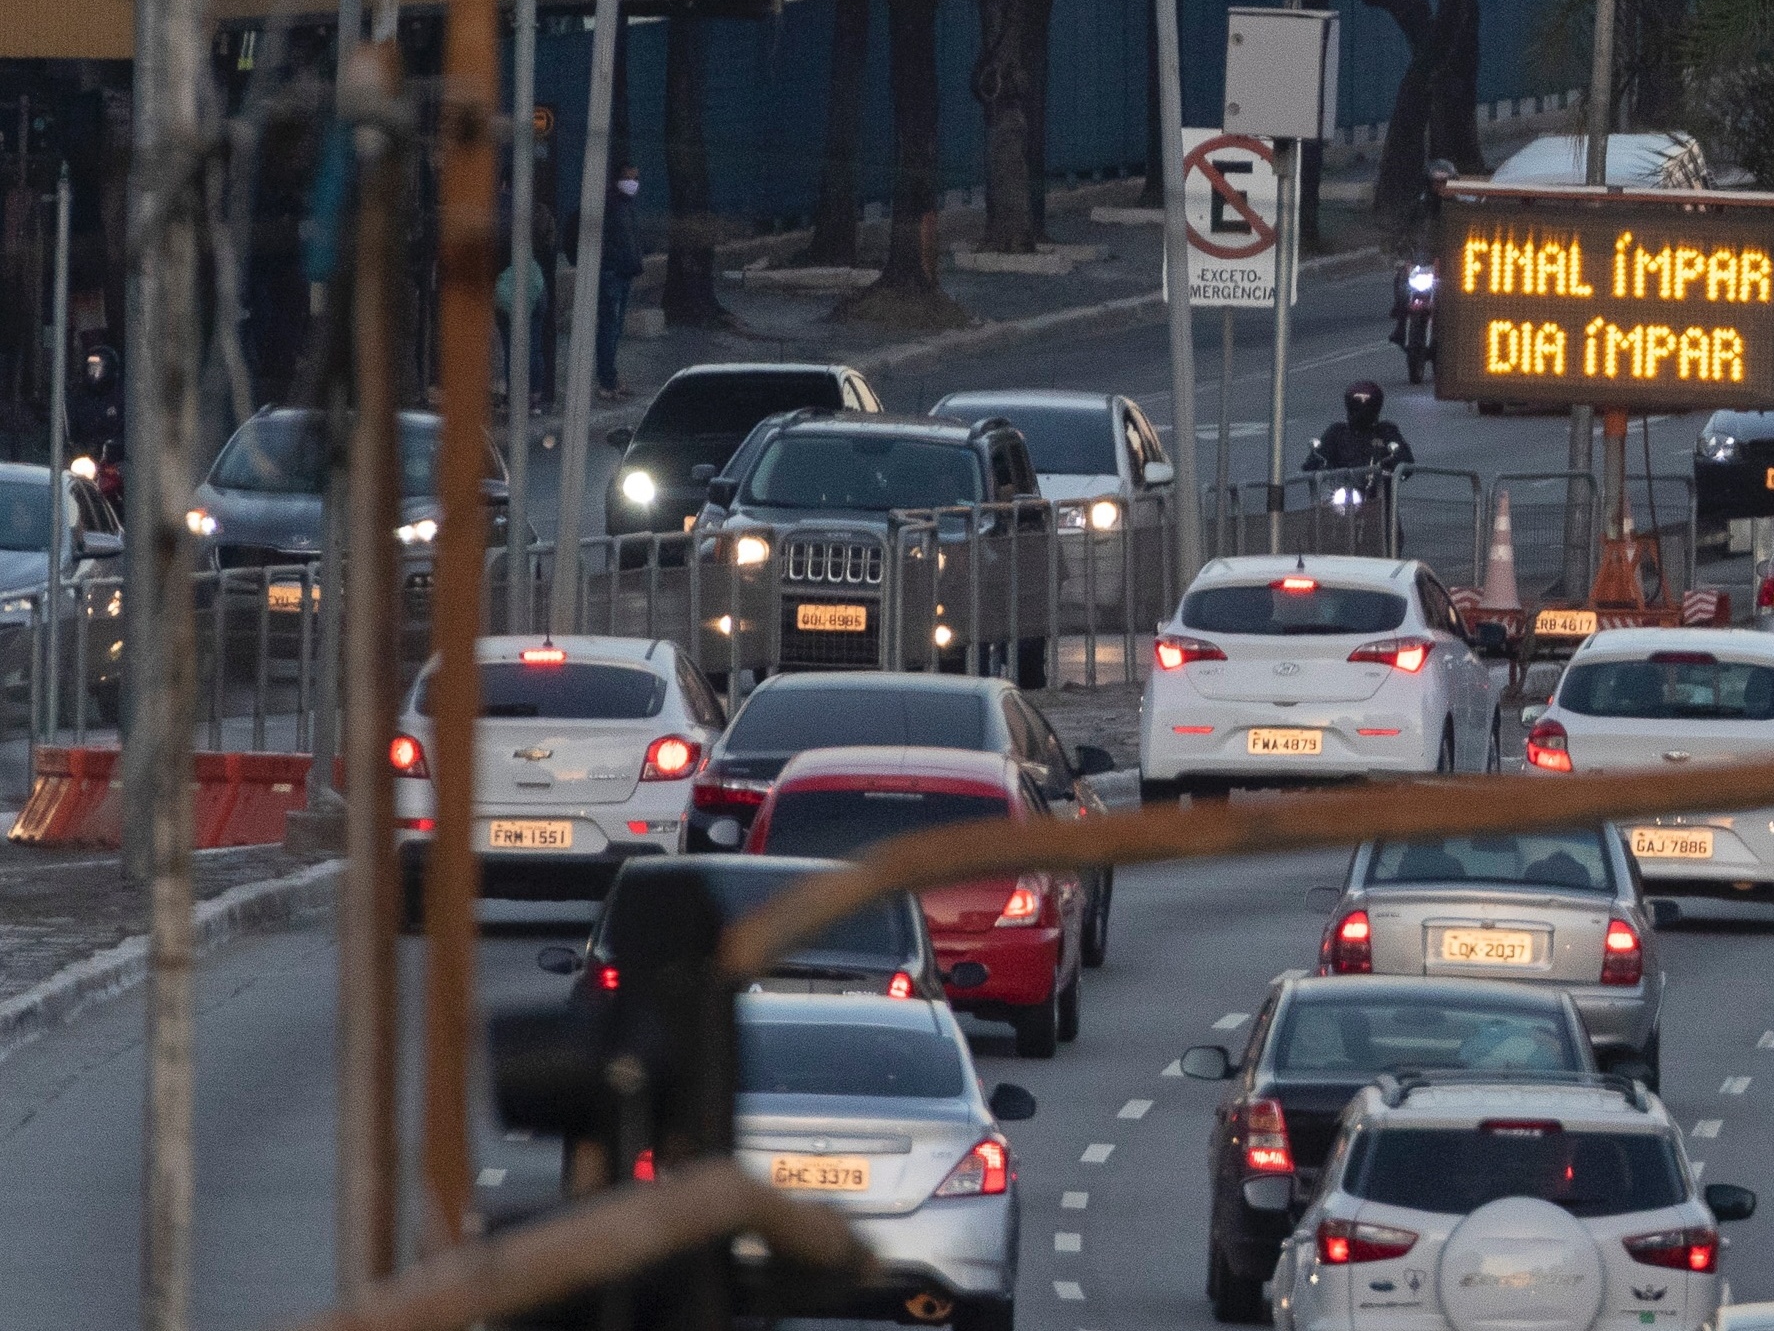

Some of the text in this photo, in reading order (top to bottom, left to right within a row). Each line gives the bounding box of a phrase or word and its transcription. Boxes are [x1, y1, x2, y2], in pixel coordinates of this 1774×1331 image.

[1200, 269, 1258, 283] EXCETO
[1463, 231, 1772, 303] FINAL ÍMPAR
[1188, 283, 1276, 301] MERGÊNCIA
[1488, 316, 1743, 382] DIA ÍMPAR
